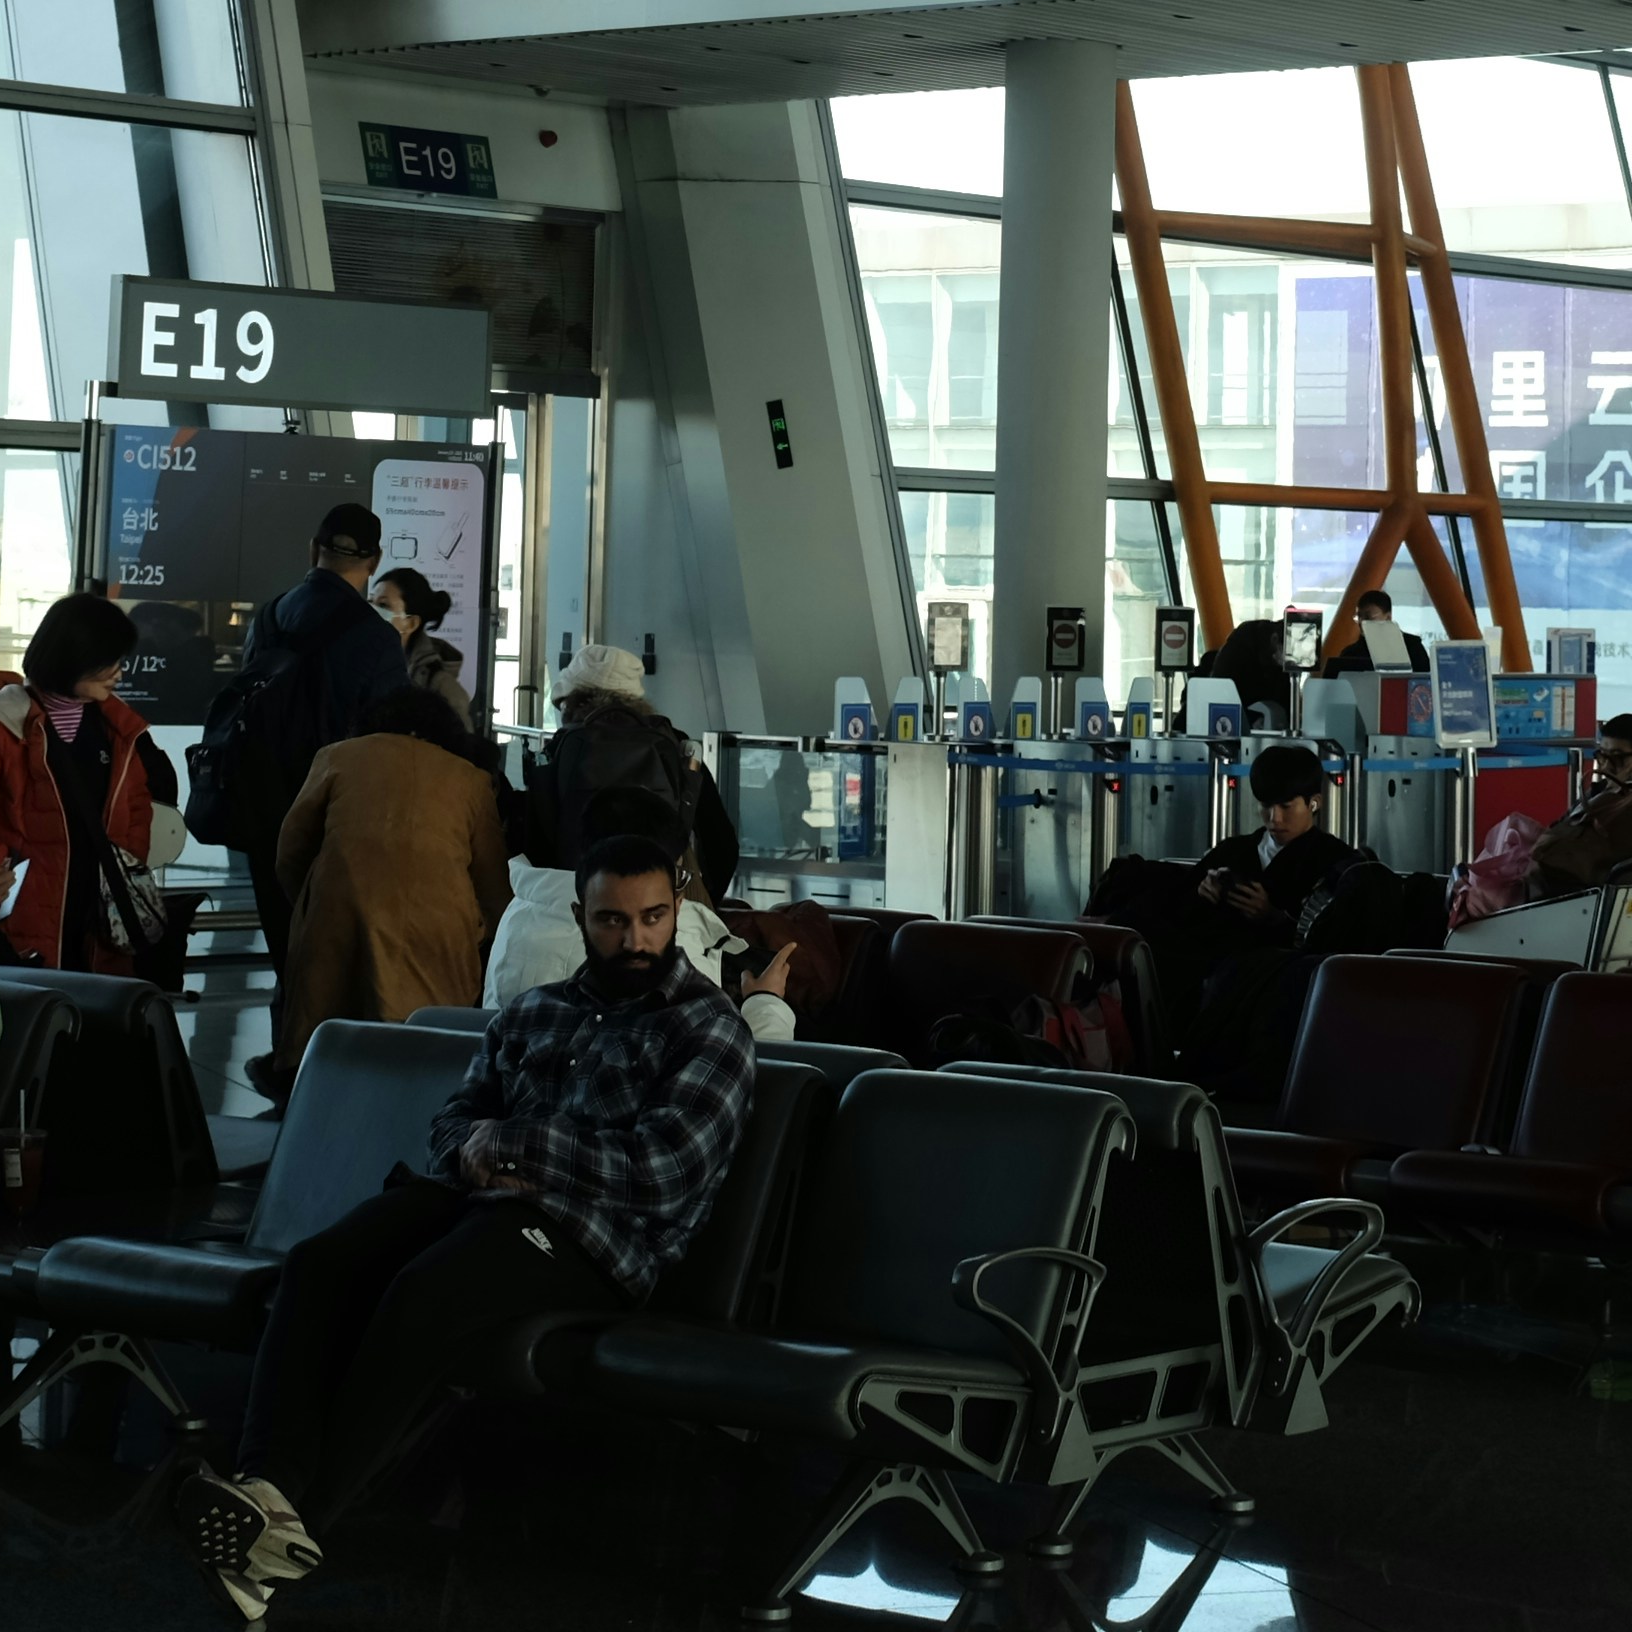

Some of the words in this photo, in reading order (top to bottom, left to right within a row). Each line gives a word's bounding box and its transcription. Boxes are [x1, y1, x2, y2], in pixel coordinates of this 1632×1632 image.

[399, 141, 457, 180] E19
[140, 301, 275, 384] E19
[136, 443, 197, 472] CI512
[122, 507, 159, 531] 台北
[120, 533, 143, 545] Taipei
[118, 564, 165, 585] 12:25
[530, 1227, 553, 1250] NIKE
